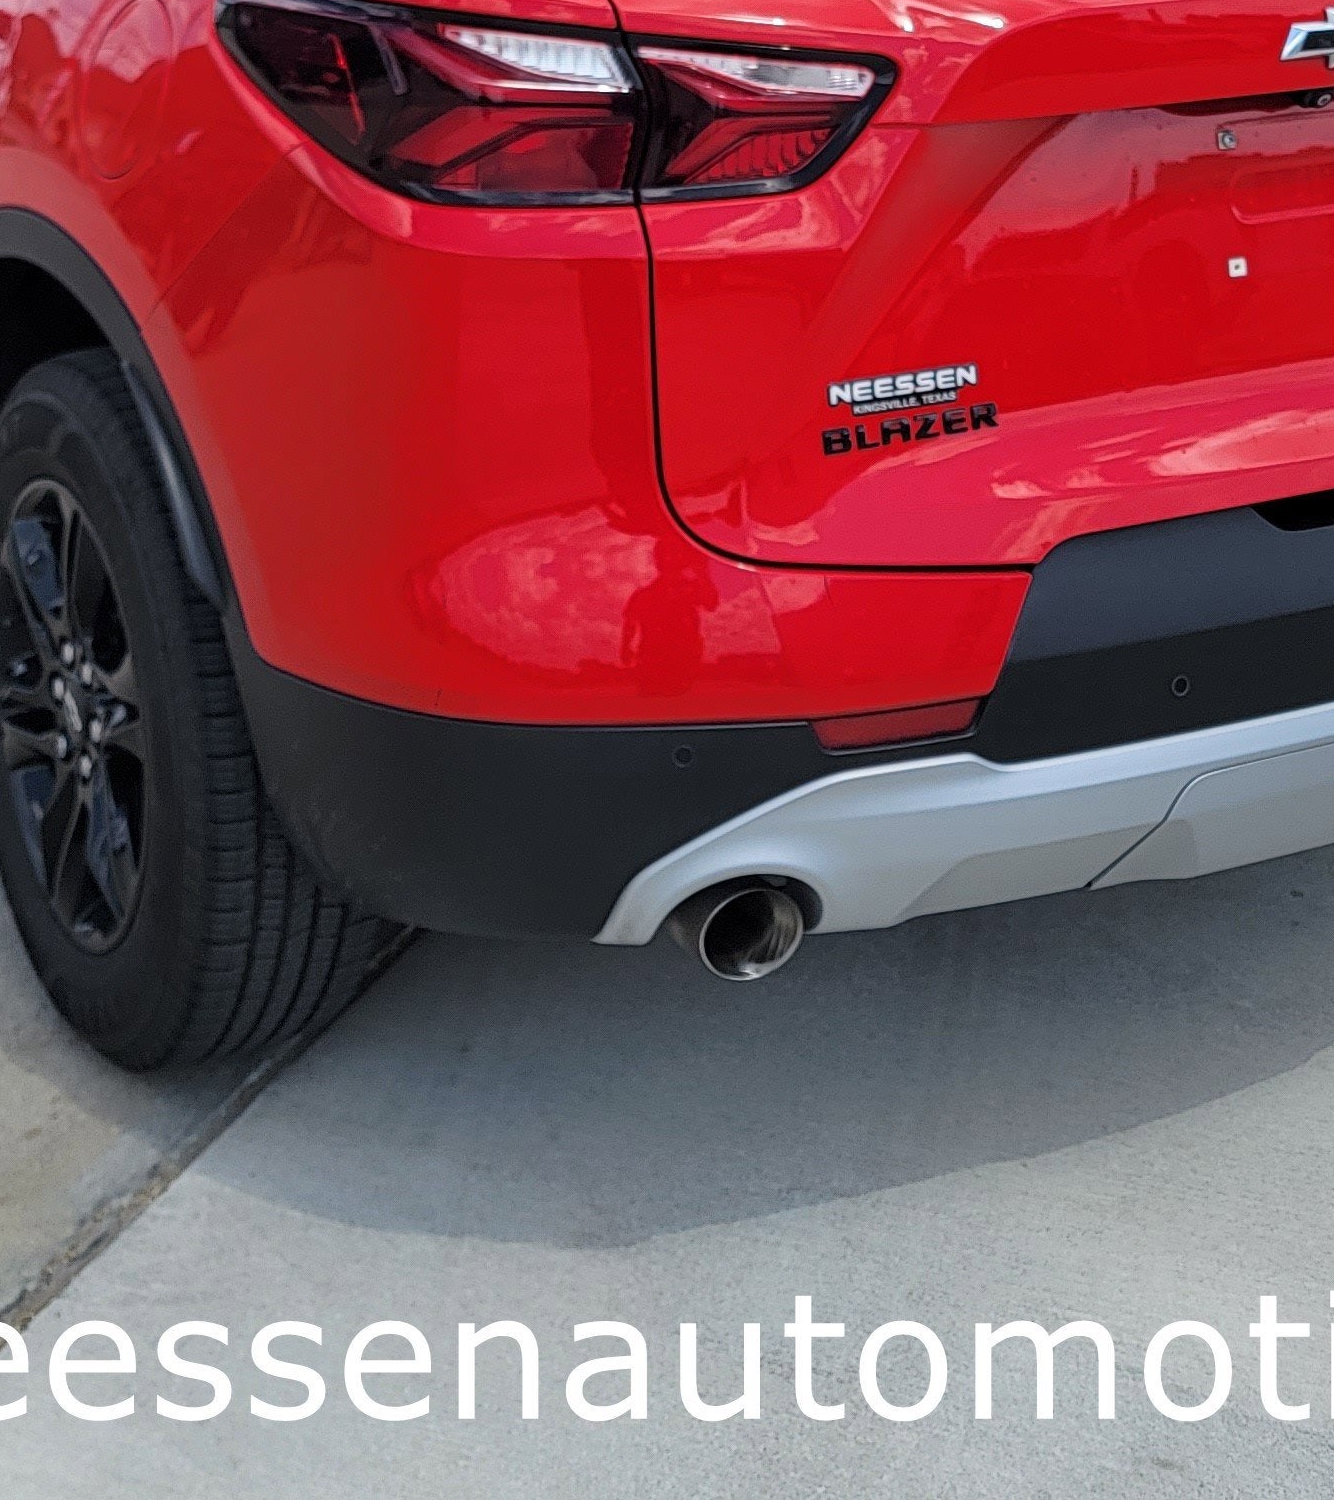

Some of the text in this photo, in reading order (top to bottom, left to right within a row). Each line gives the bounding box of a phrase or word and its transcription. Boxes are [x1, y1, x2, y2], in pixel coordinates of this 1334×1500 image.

[828, 365, 978, 406] NEESSEN
[922, 390, 957, 406] TEXAS
[822, 403, 1000, 456] BLAZER
